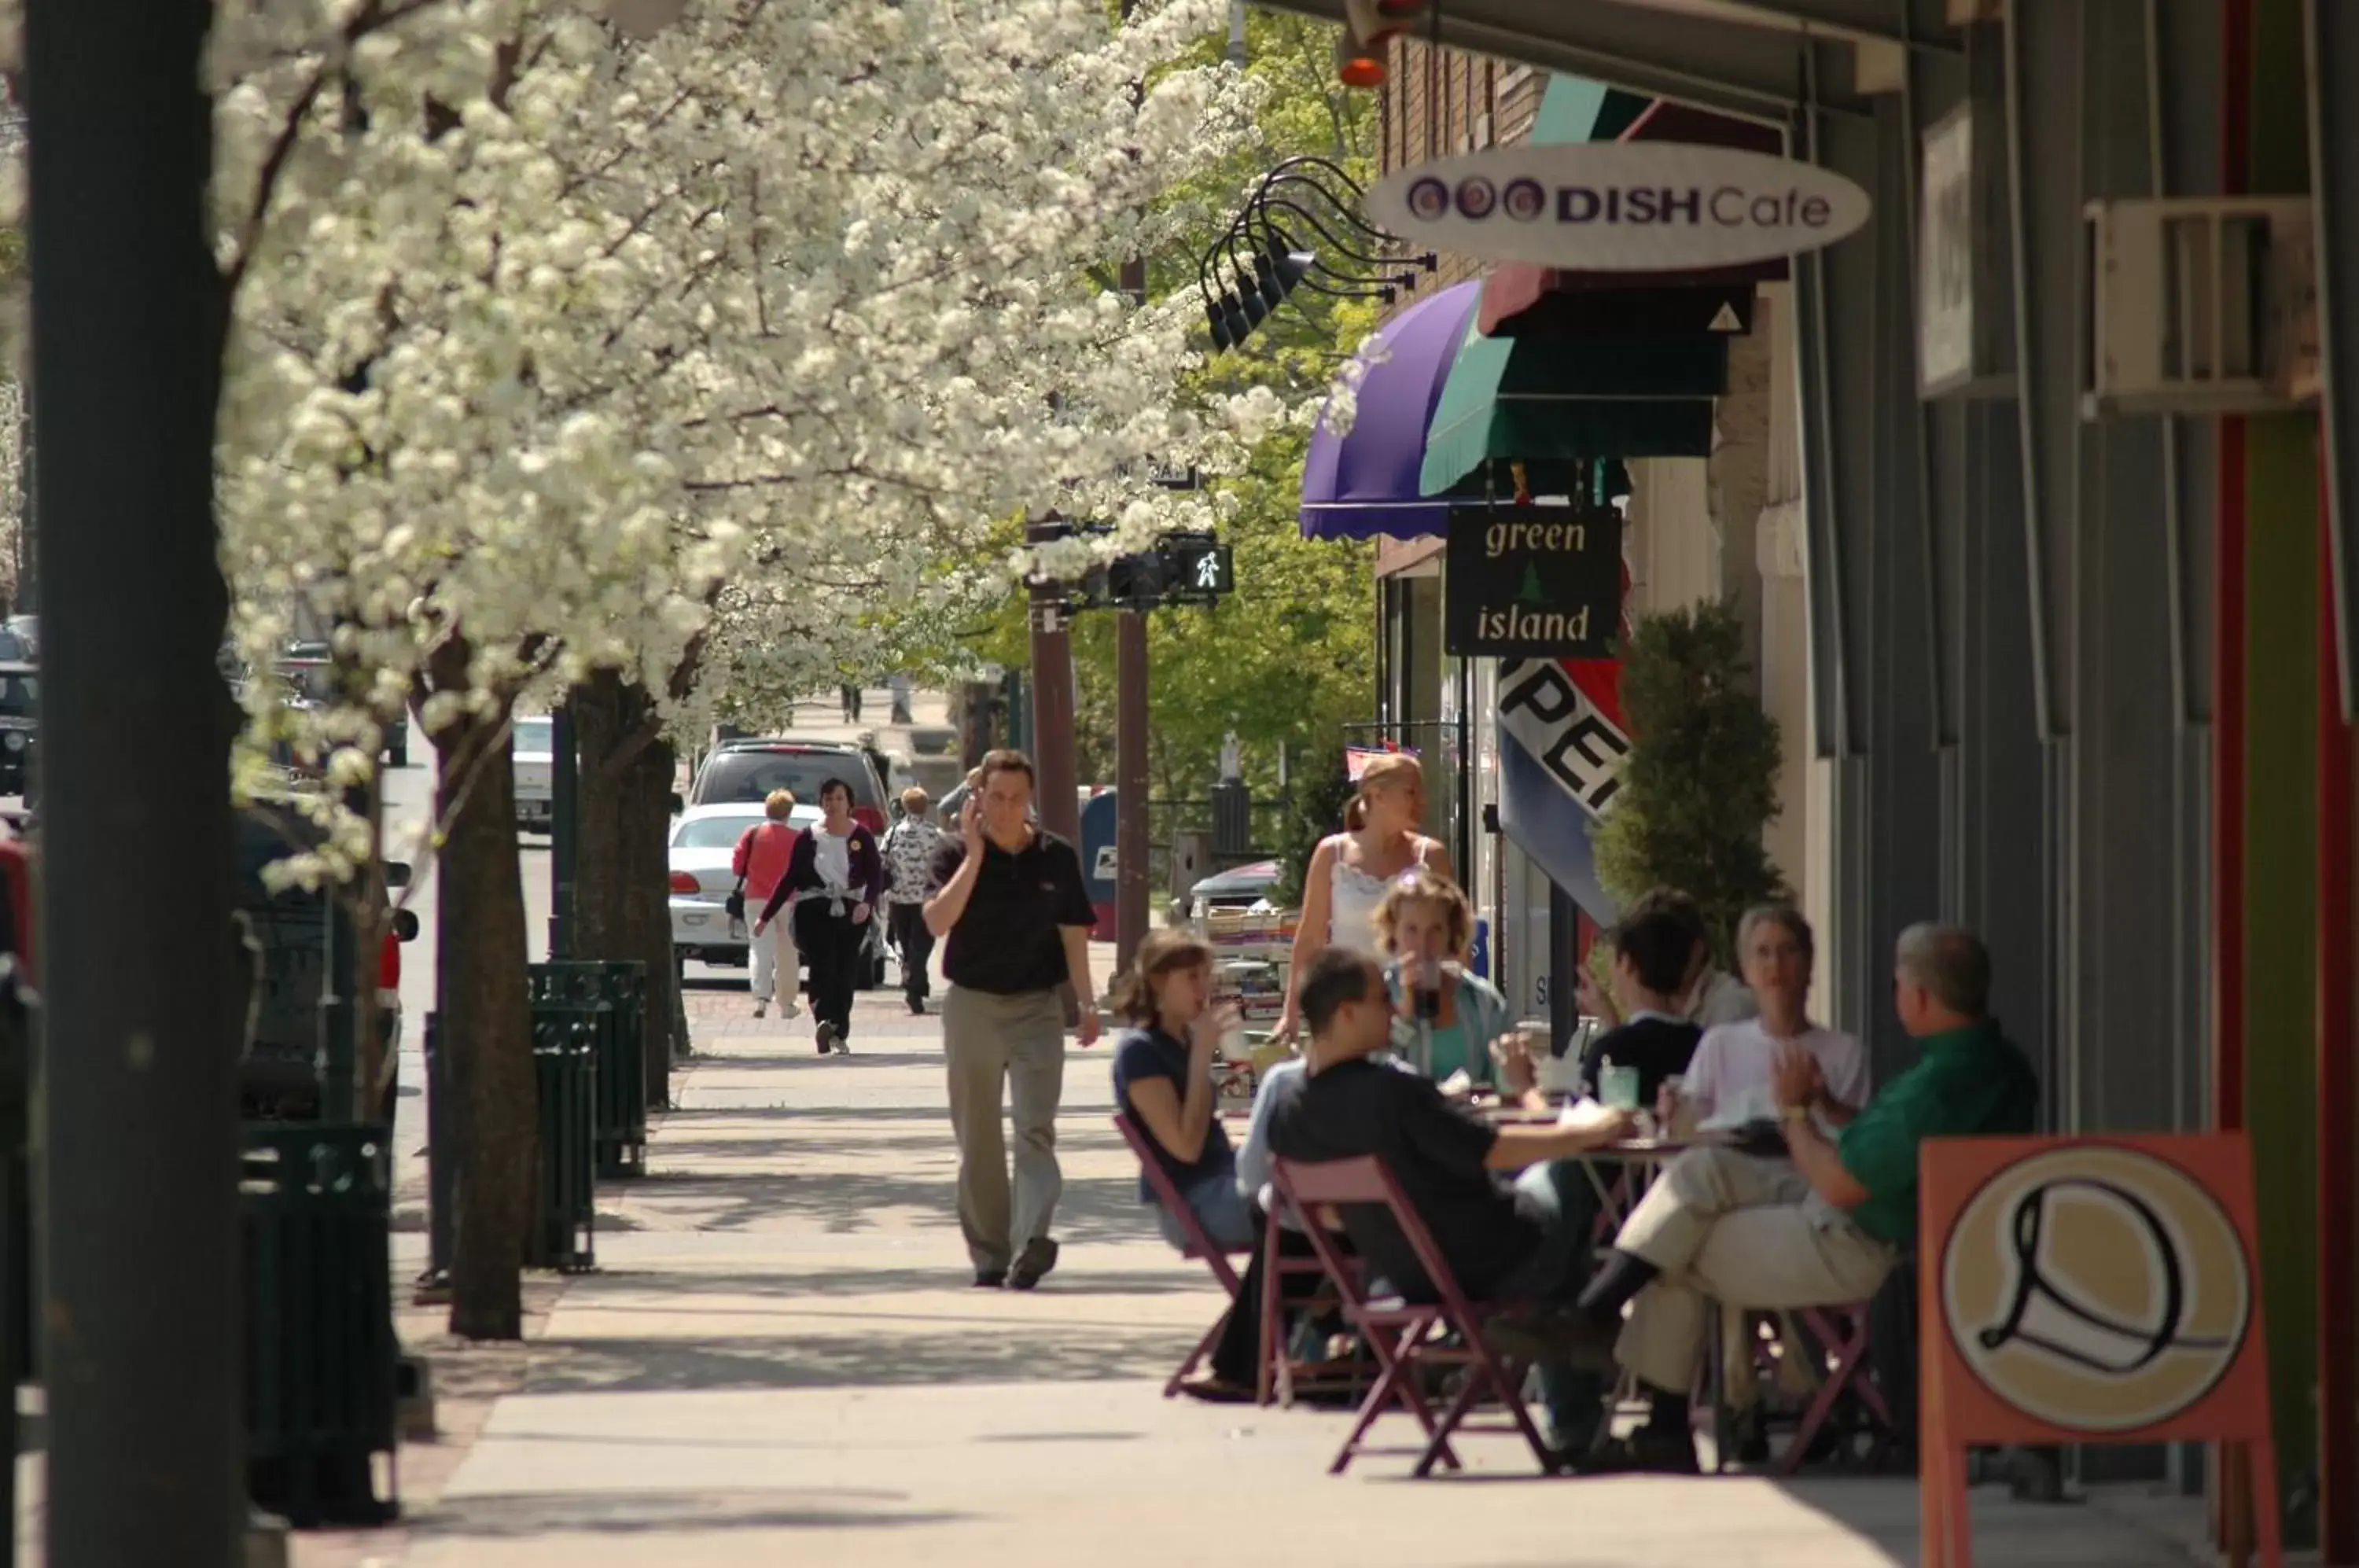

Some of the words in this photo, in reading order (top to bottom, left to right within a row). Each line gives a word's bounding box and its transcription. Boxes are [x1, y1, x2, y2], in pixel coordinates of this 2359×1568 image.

[1555, 186, 1702, 226] DISH
[1708, 186, 1832, 228] Cafe
[1485, 522, 1586, 558] green
[1478, 603, 1590, 641] island
[1500, 657, 1628, 811] PE
